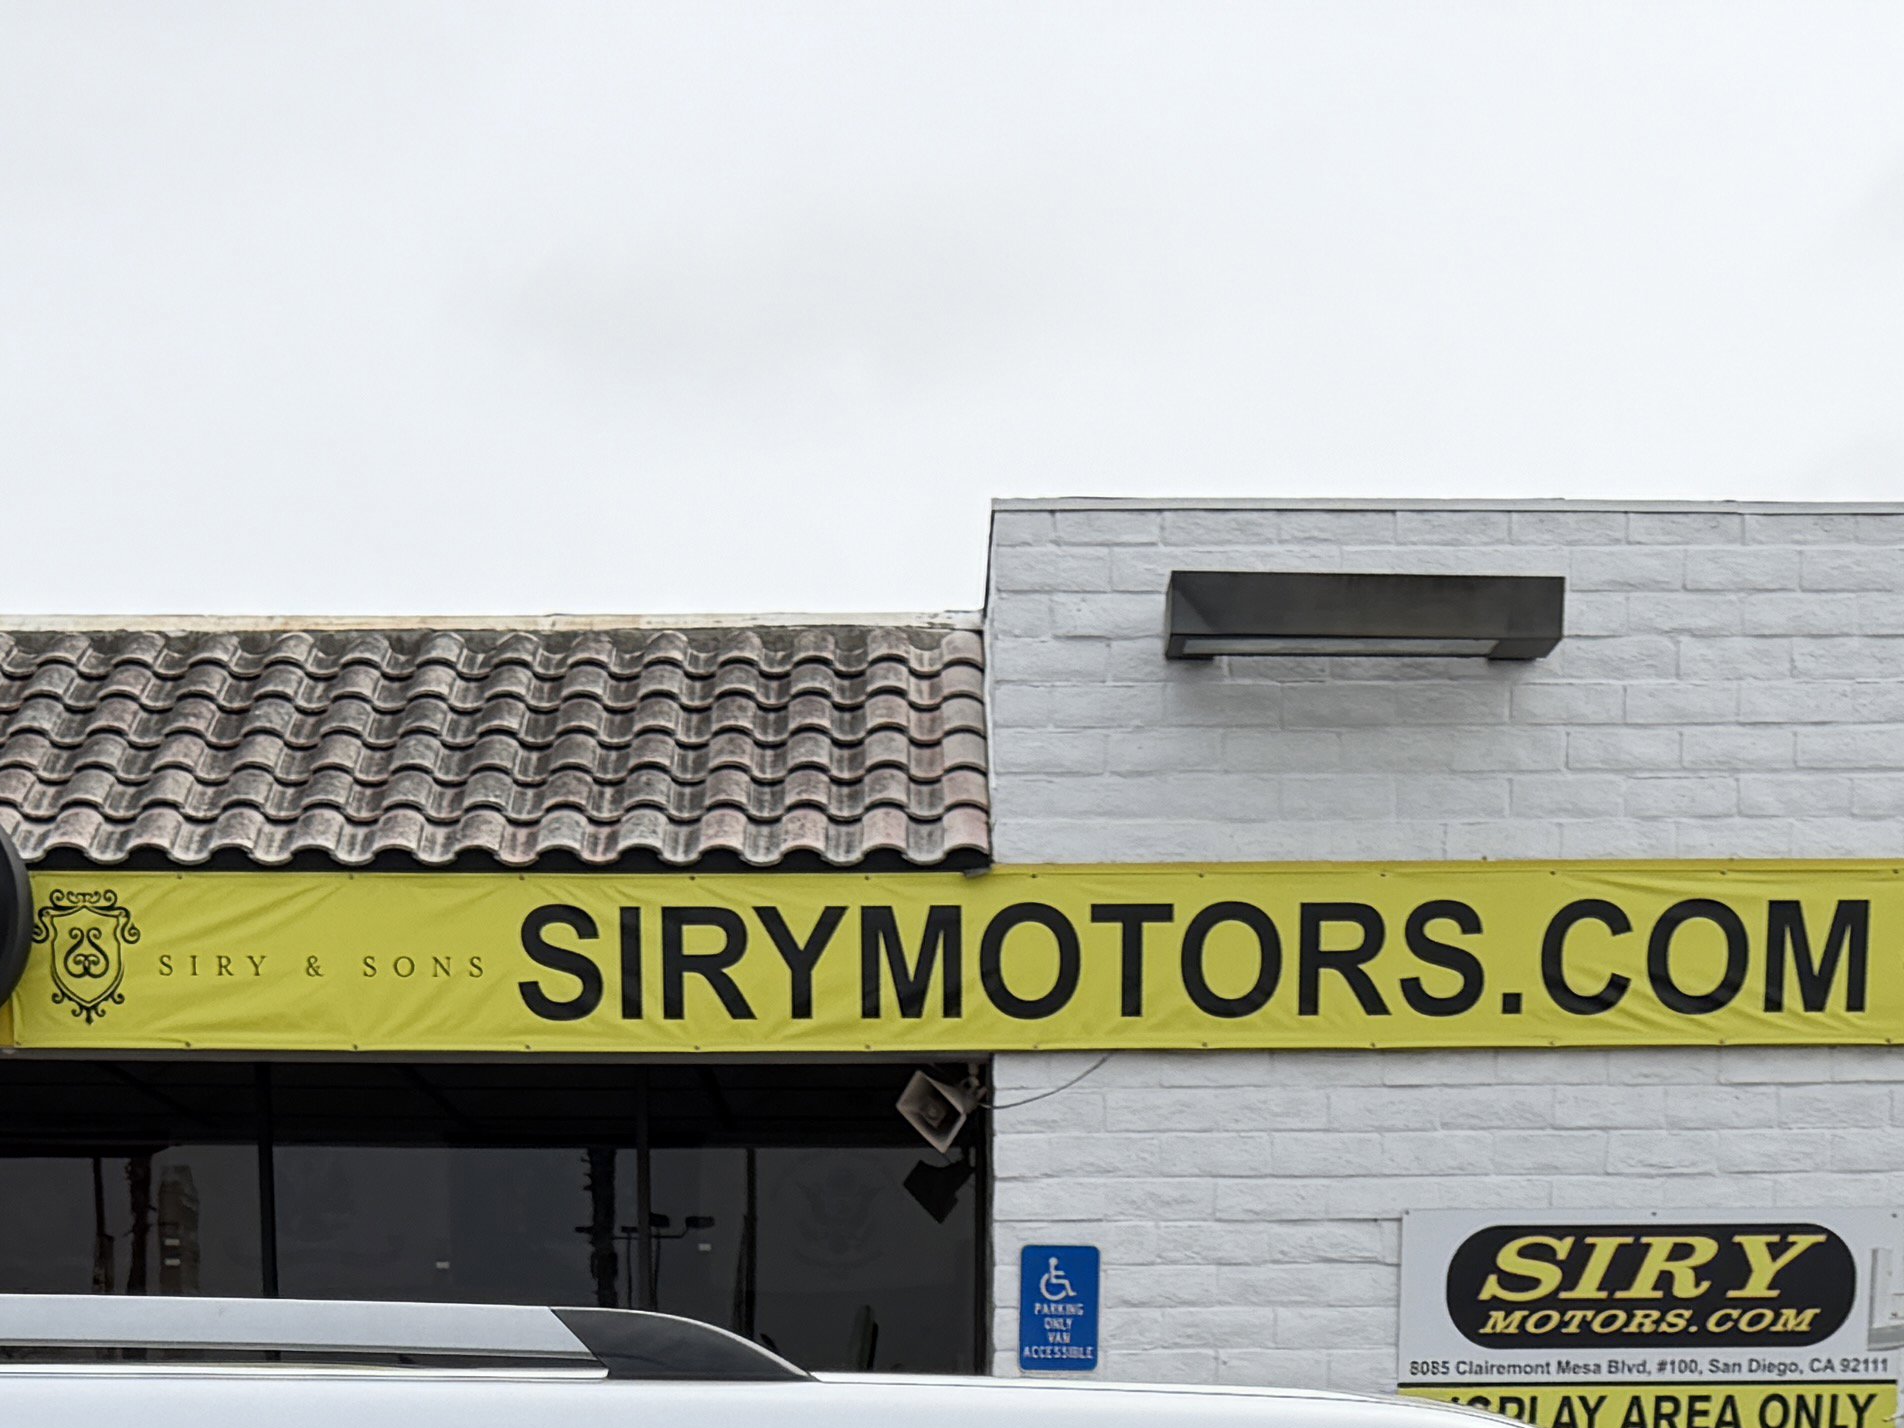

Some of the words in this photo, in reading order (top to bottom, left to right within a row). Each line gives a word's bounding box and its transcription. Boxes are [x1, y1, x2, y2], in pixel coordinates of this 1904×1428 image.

[158, 953, 269, 979] SIRY
[305, 956, 325, 978] &
[362, 956, 486, 980] SONS
[518, 898, 1870, 1021] SIRYMOTORS.COM
[1478, 1233, 1828, 1302] SIRY
[1478, 1307, 1821, 1336] MOTORS.COM
[1409, 1360, 1450, 1376] 8085
[1455, 1360, 1551, 1376] Clairemont
[1556, 1359, 1601, 1375] Mesa
[1607, 1359, 1652, 1376] Blvd,
[1656, 1359, 1703, 1375] #100,
[1708, 1359, 1742, 1374] San
[1747, 1358, 1804, 1376] Diego,
[1808, 1358, 1835, 1373] CA
[1839, 1357, 1889, 1373] 92111
